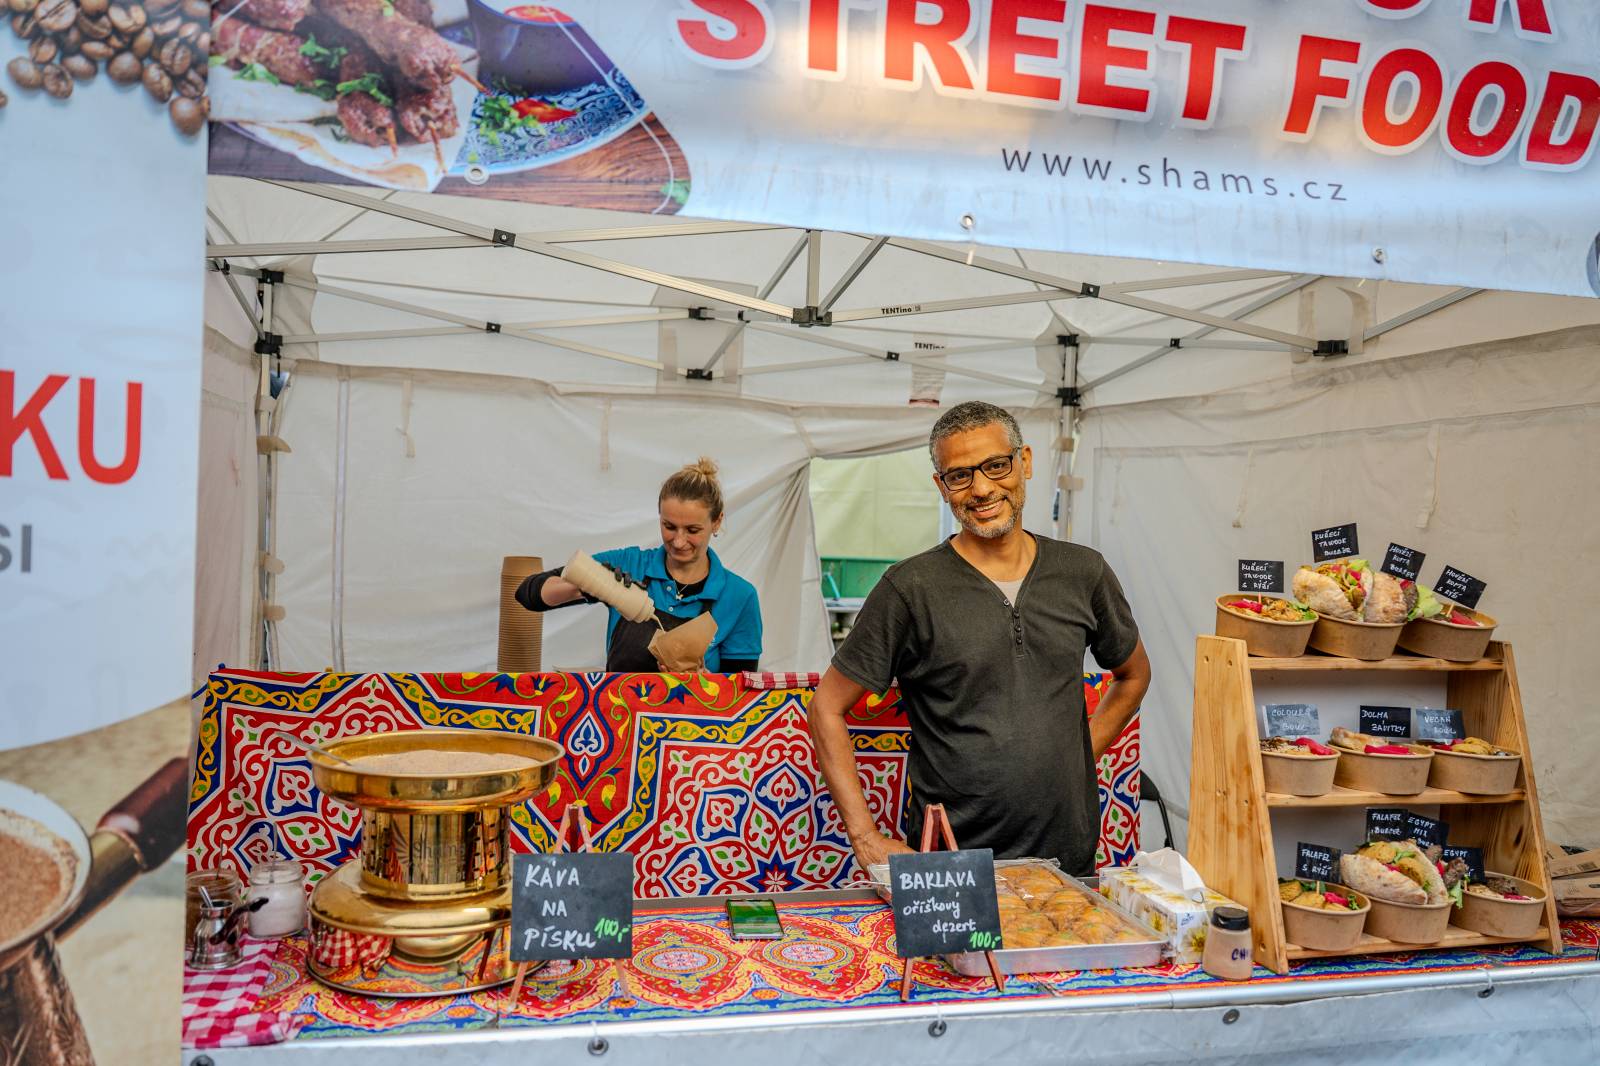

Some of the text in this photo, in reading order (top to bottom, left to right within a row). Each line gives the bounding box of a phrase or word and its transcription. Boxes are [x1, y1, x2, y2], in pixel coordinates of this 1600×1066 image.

[676, 0, 1600, 165] STREET FOOD
[1001, 148, 1348, 201] www.shams.cz
[525, 860, 580, 888] KÁVA
[899, 870, 976, 890] BAKLAVA
[542, 900, 567, 917] NA
[523, 925, 596, 952] PÍSKU
